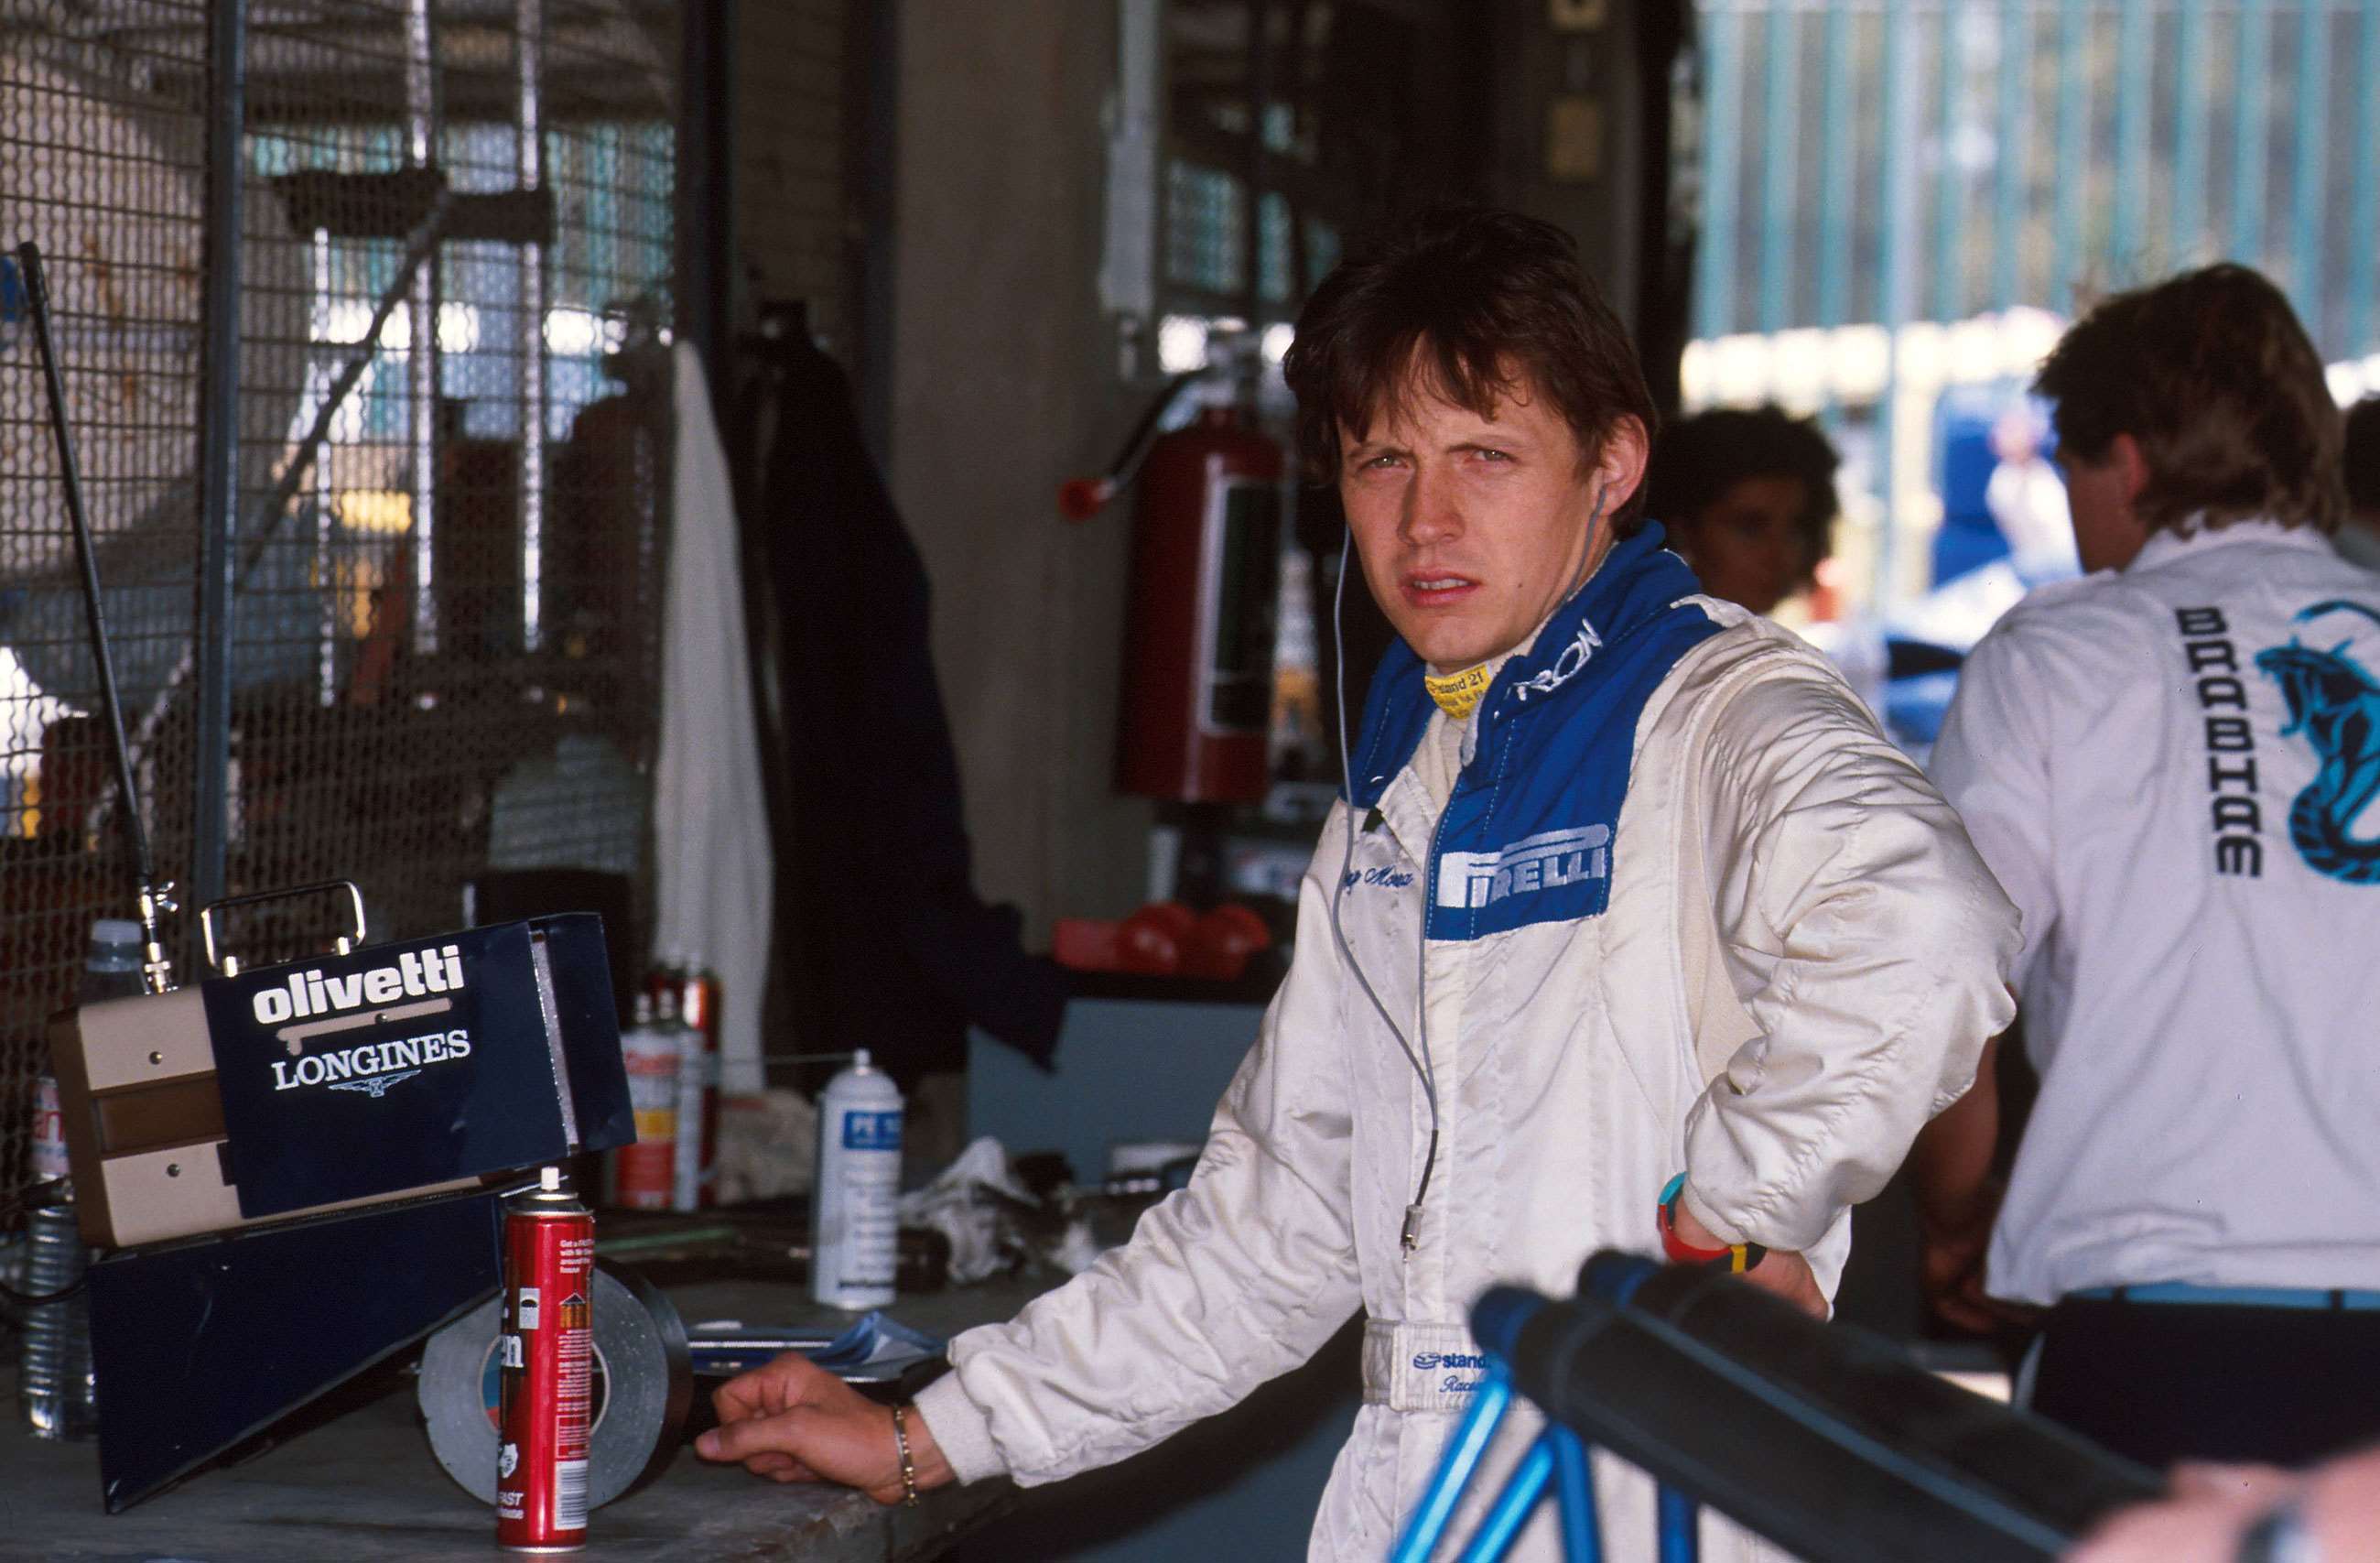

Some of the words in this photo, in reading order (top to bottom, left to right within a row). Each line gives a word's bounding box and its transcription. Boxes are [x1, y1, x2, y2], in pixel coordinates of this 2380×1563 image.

[1468, 670, 1484, 686] 21
[2175, 607, 2264, 877] BRABHAM
[1437, 824, 1609, 908] PIRELLI
[253, 944, 464, 1025] olivetti
[271, 1029, 471, 1091] LONGINES
